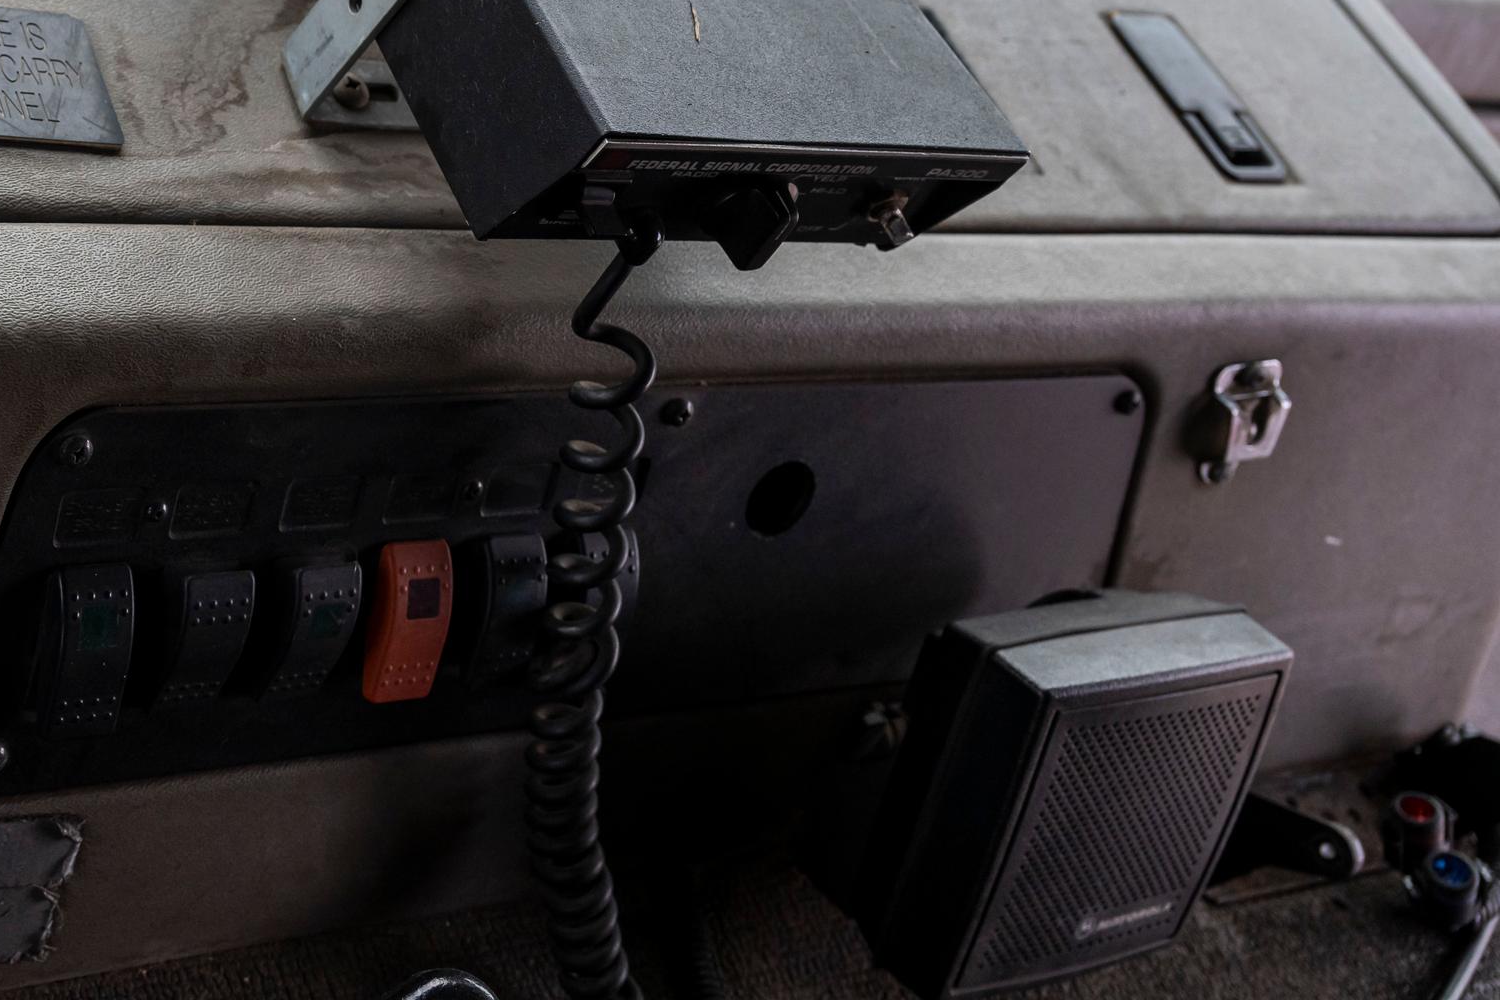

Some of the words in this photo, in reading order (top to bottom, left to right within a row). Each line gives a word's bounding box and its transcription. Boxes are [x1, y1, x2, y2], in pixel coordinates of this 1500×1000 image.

[20, 20, 46, 51] IS
[0, 53, 85, 89] CARRY
[627, 159, 700, 171] FEDERAL
[701, 161, 762, 173] SIGNAL
[764, 162, 878, 175] CORPORATION
[671, 170, 720, 179] RADIO
[924, 167, 990, 179] PA300
